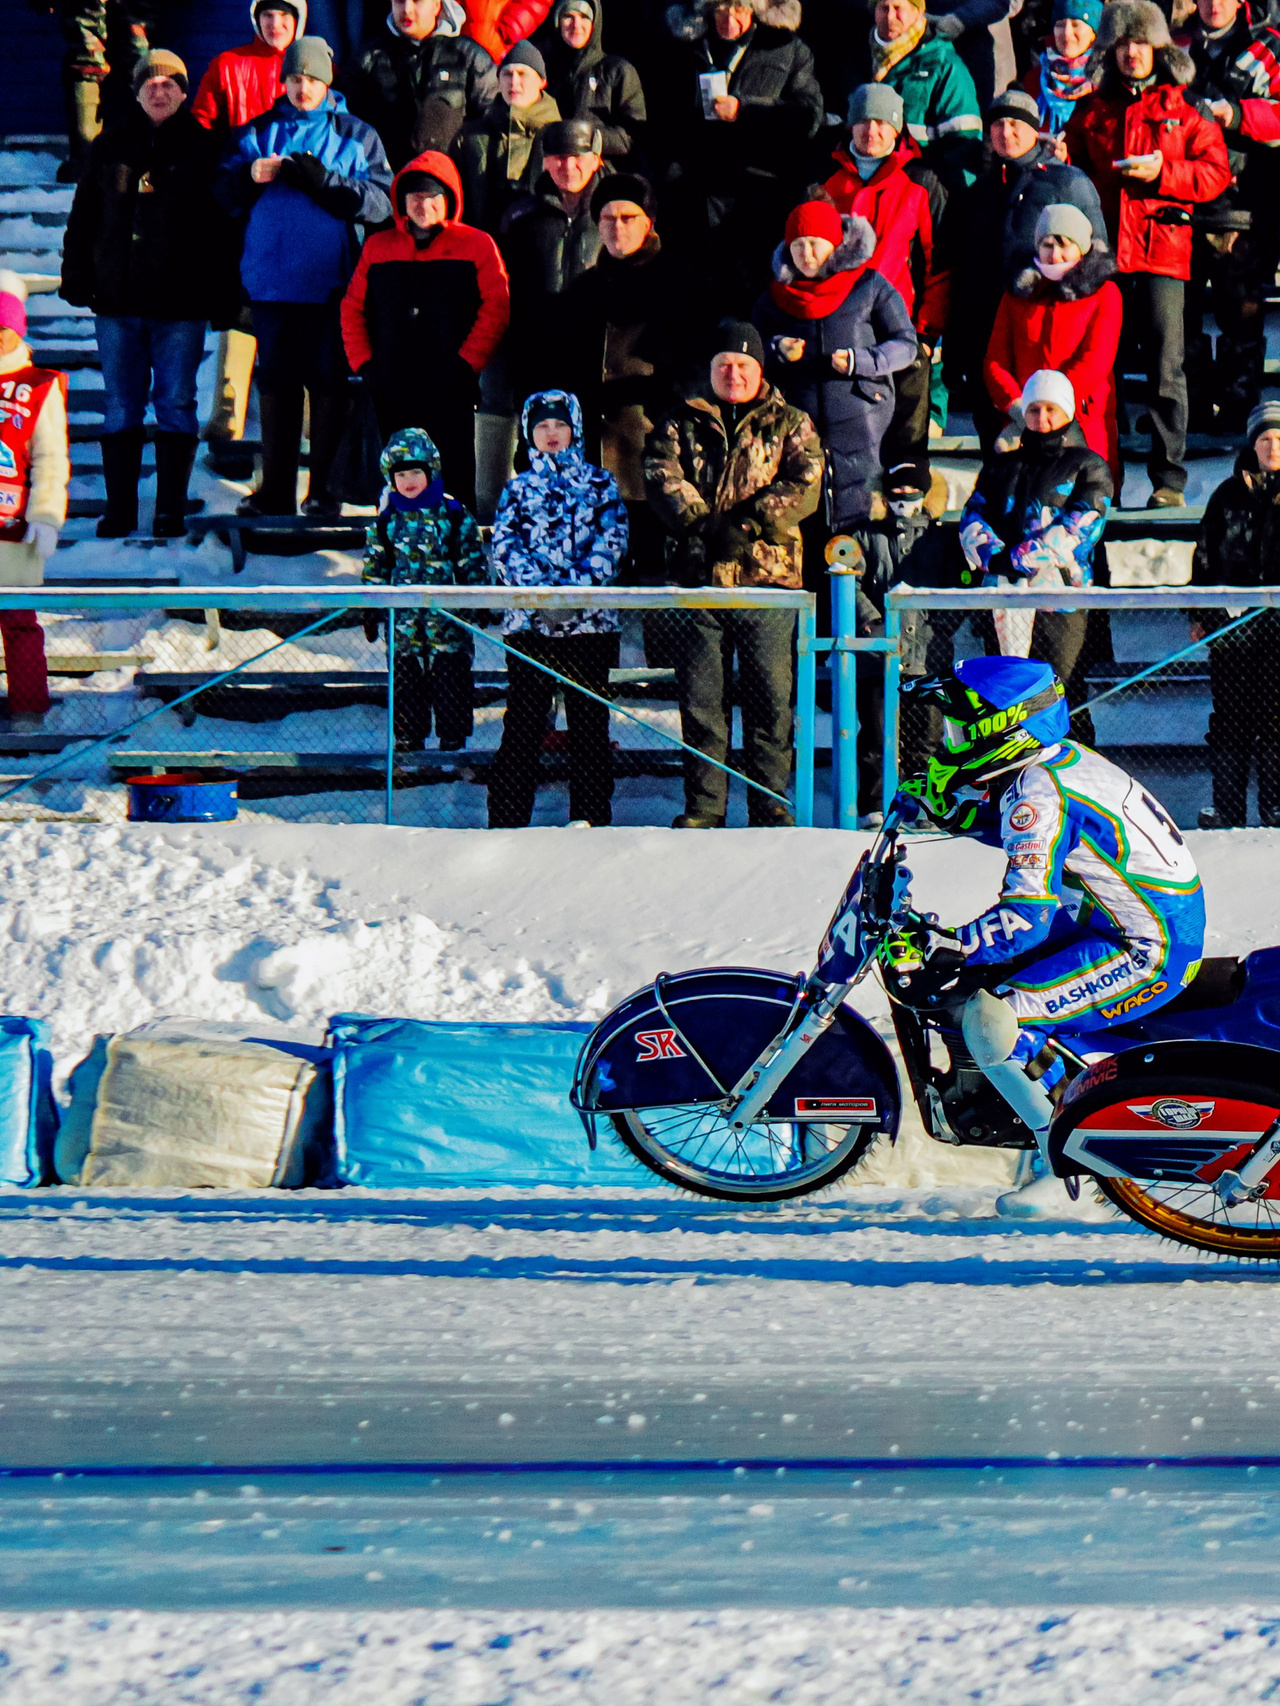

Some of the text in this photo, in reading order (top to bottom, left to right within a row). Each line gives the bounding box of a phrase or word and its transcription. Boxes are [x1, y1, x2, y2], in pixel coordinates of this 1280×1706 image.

[968, 701, 1028, 740] 100%
[1015, 841, 1041, 851] Castrol
[956, 908, 1033, 955] UFA
[1101, 981, 1169, 1020] WACO
[635, 1028, 687, 1062] SR
